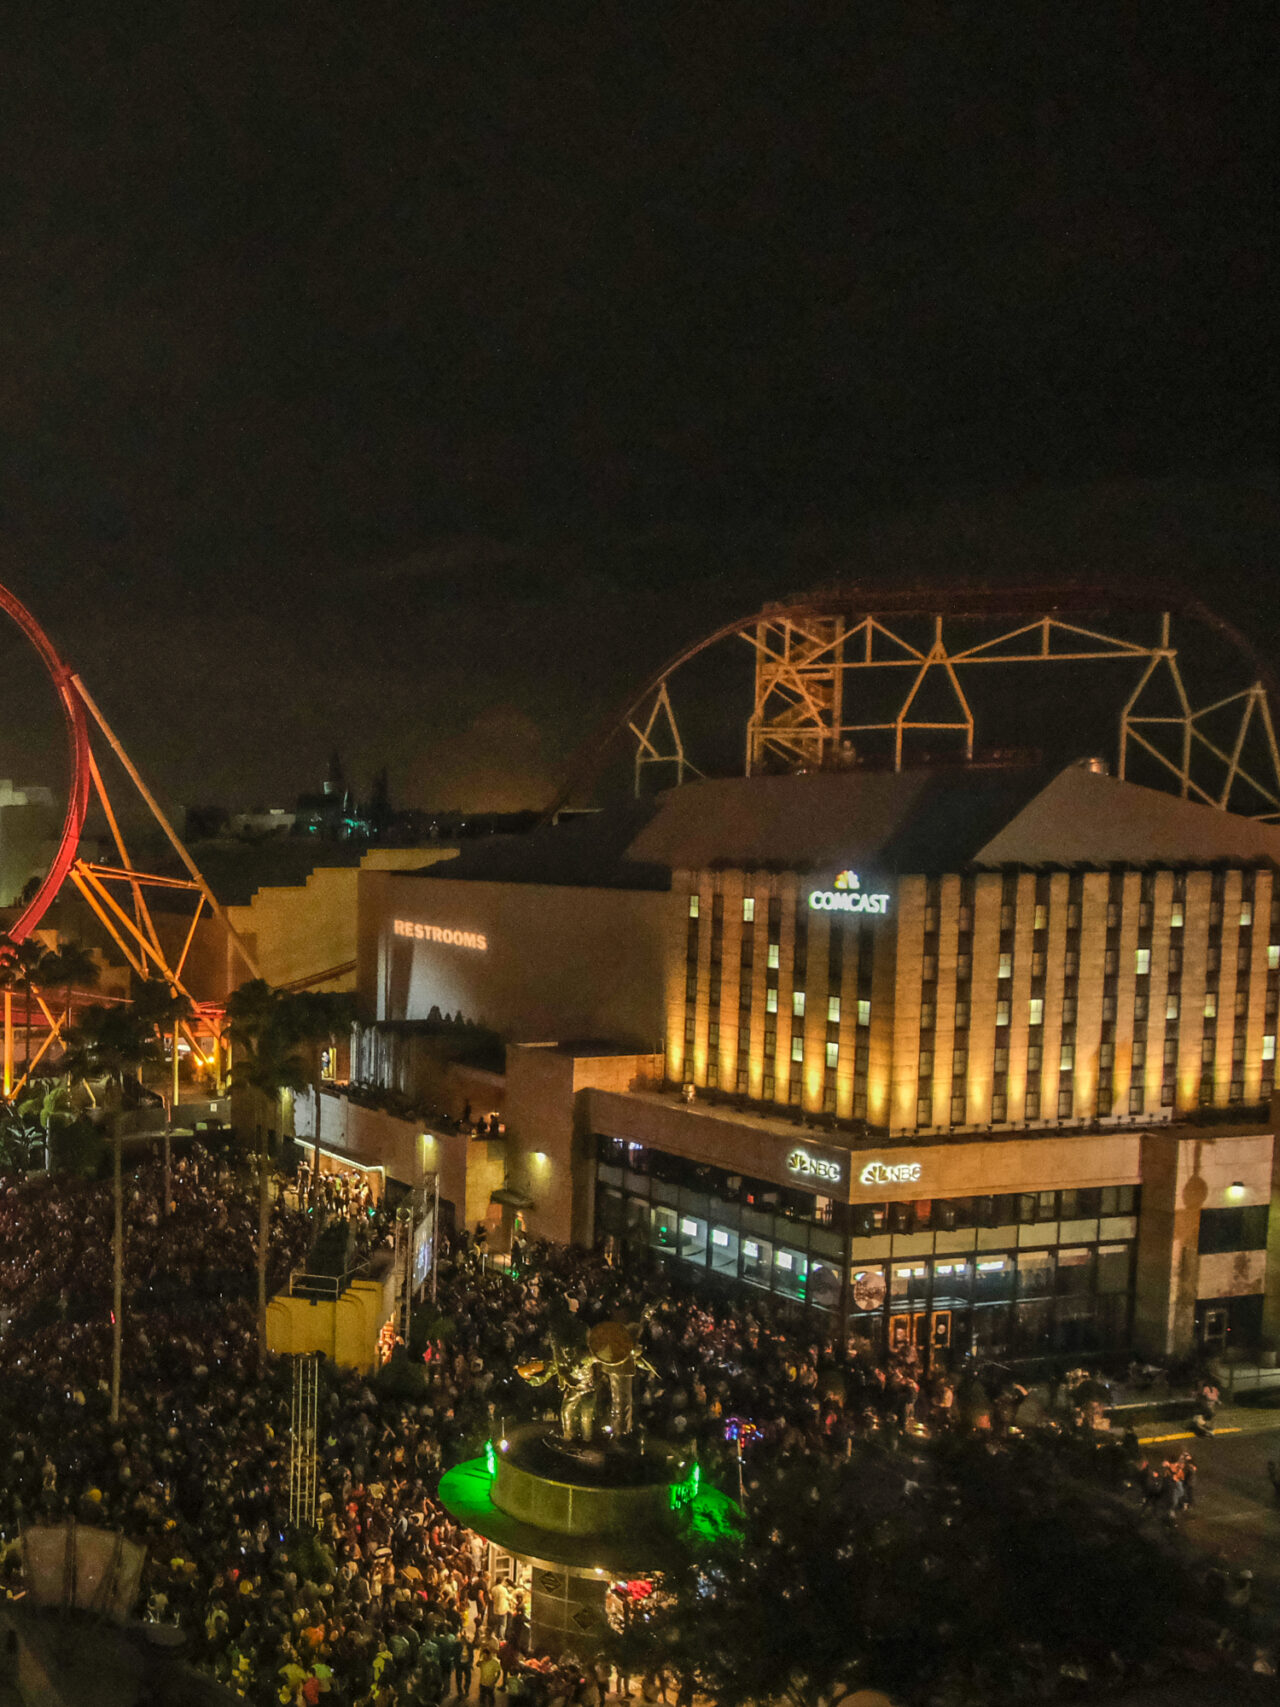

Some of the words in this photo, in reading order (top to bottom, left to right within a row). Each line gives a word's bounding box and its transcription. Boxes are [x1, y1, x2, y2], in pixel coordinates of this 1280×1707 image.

[808, 890, 890, 914] COMCAST
[393, 919, 489, 951] RESTROOMS
[809, 1158, 841, 1181] NBC
[889, 1163, 922, 1182] NBC
